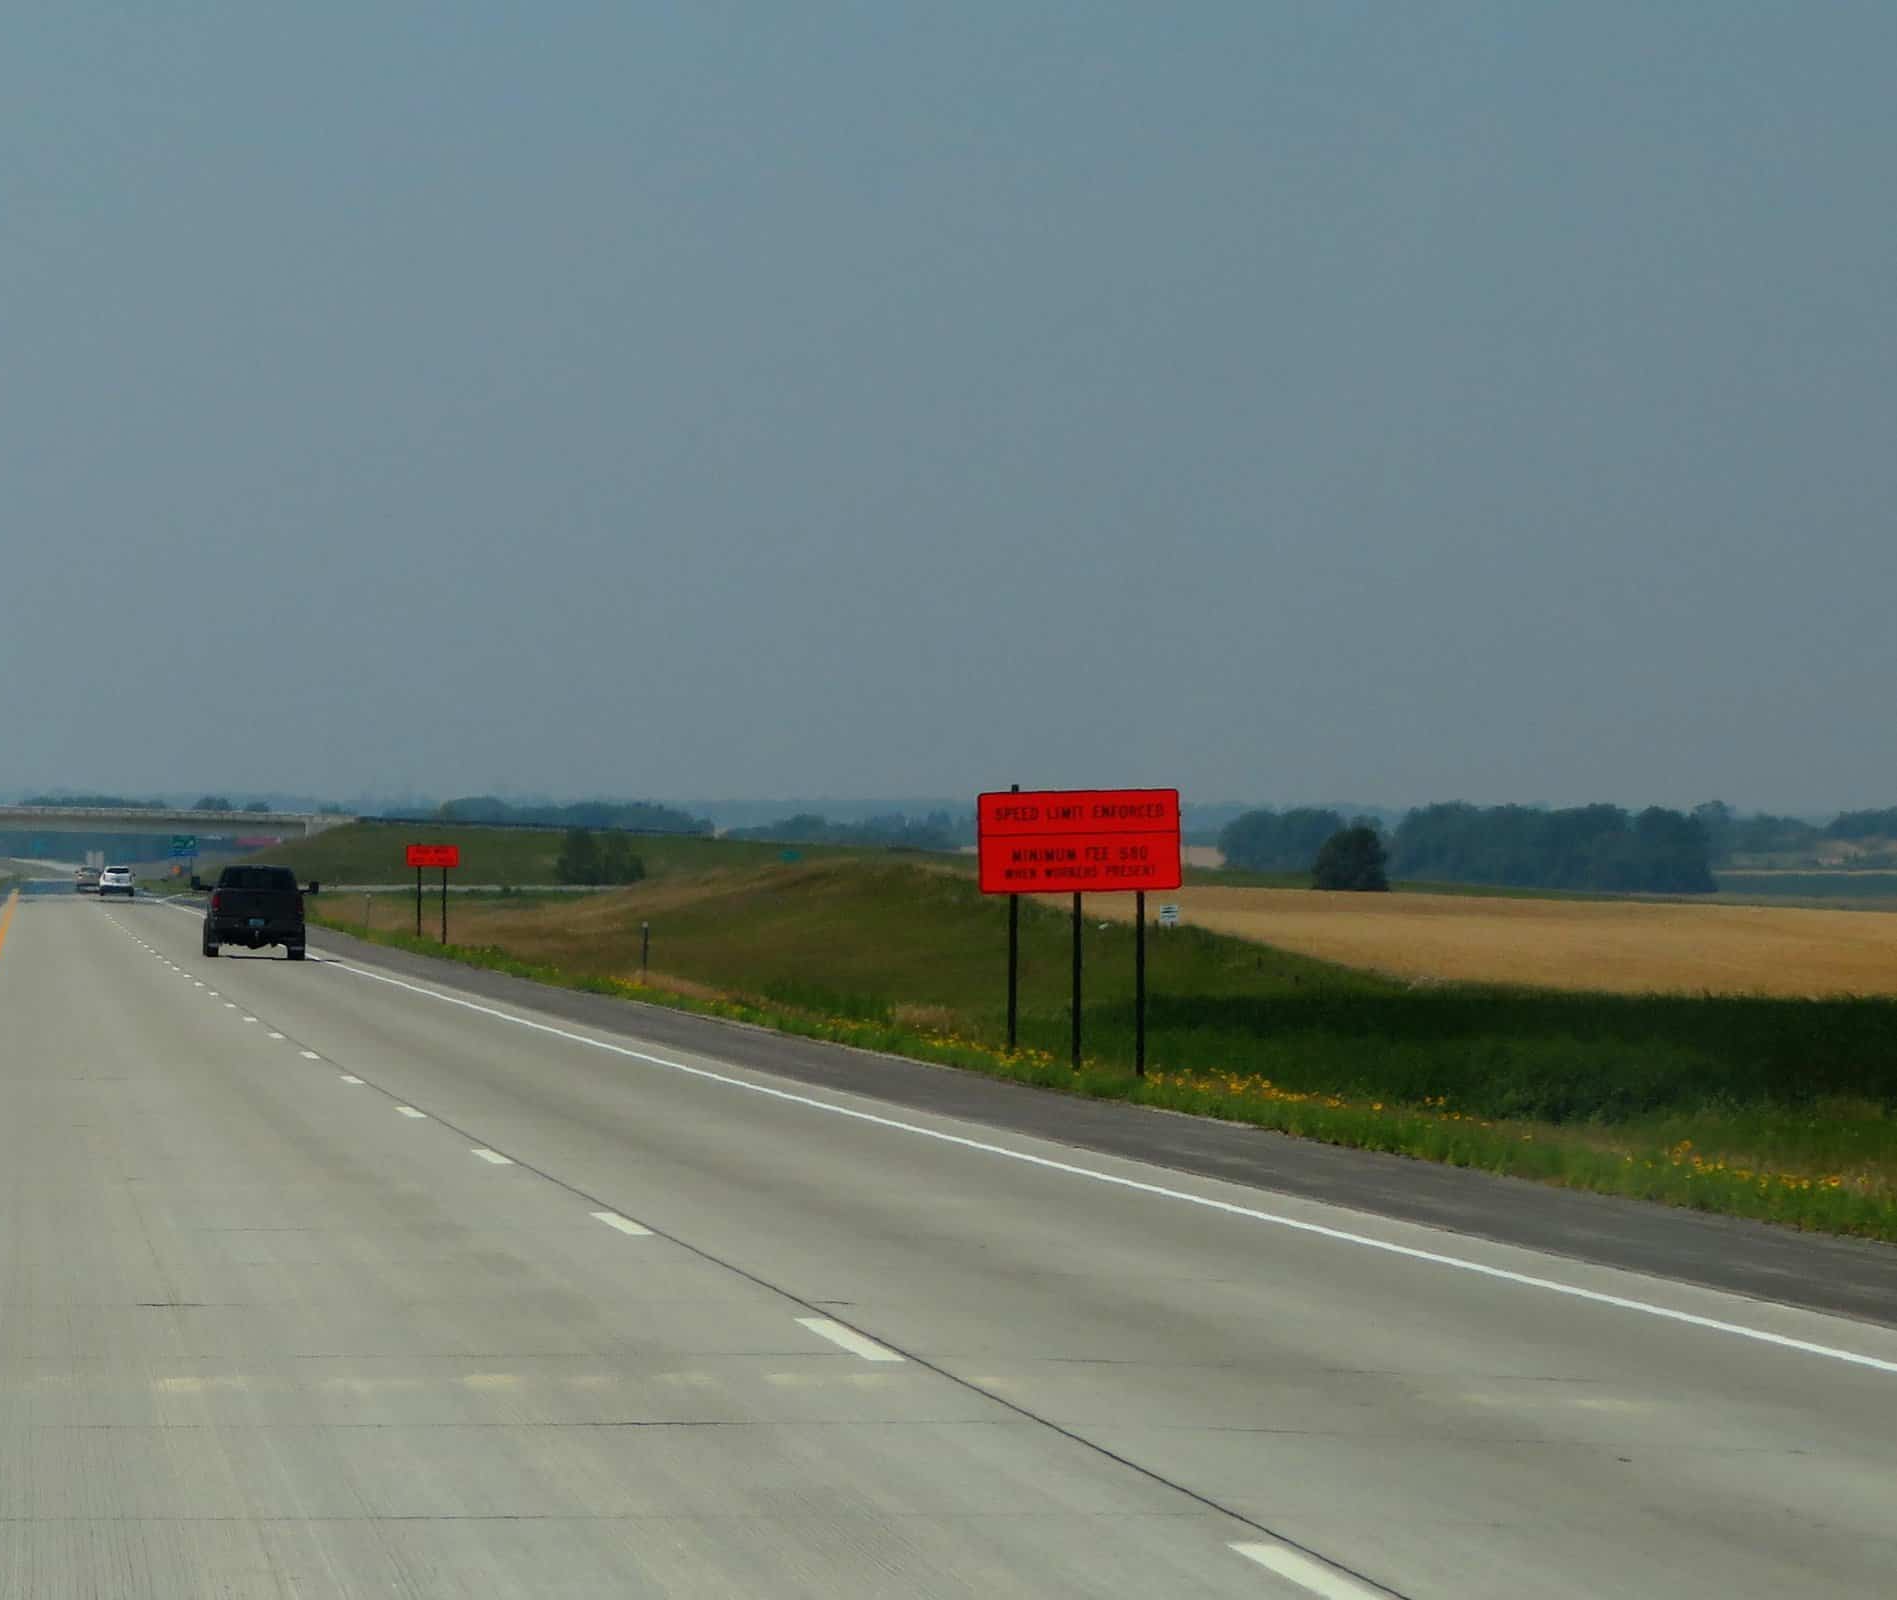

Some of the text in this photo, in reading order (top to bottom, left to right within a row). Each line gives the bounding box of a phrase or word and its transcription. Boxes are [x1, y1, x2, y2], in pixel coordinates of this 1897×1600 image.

[994, 803, 1164, 821] SPEED LIMIT ENFORCED
[1012, 848, 1076, 862] MINIMUM
[1086, 847, 1109, 861] FEE
[1005, 865, 1156, 879] WHEN WORKERS PRESENT
